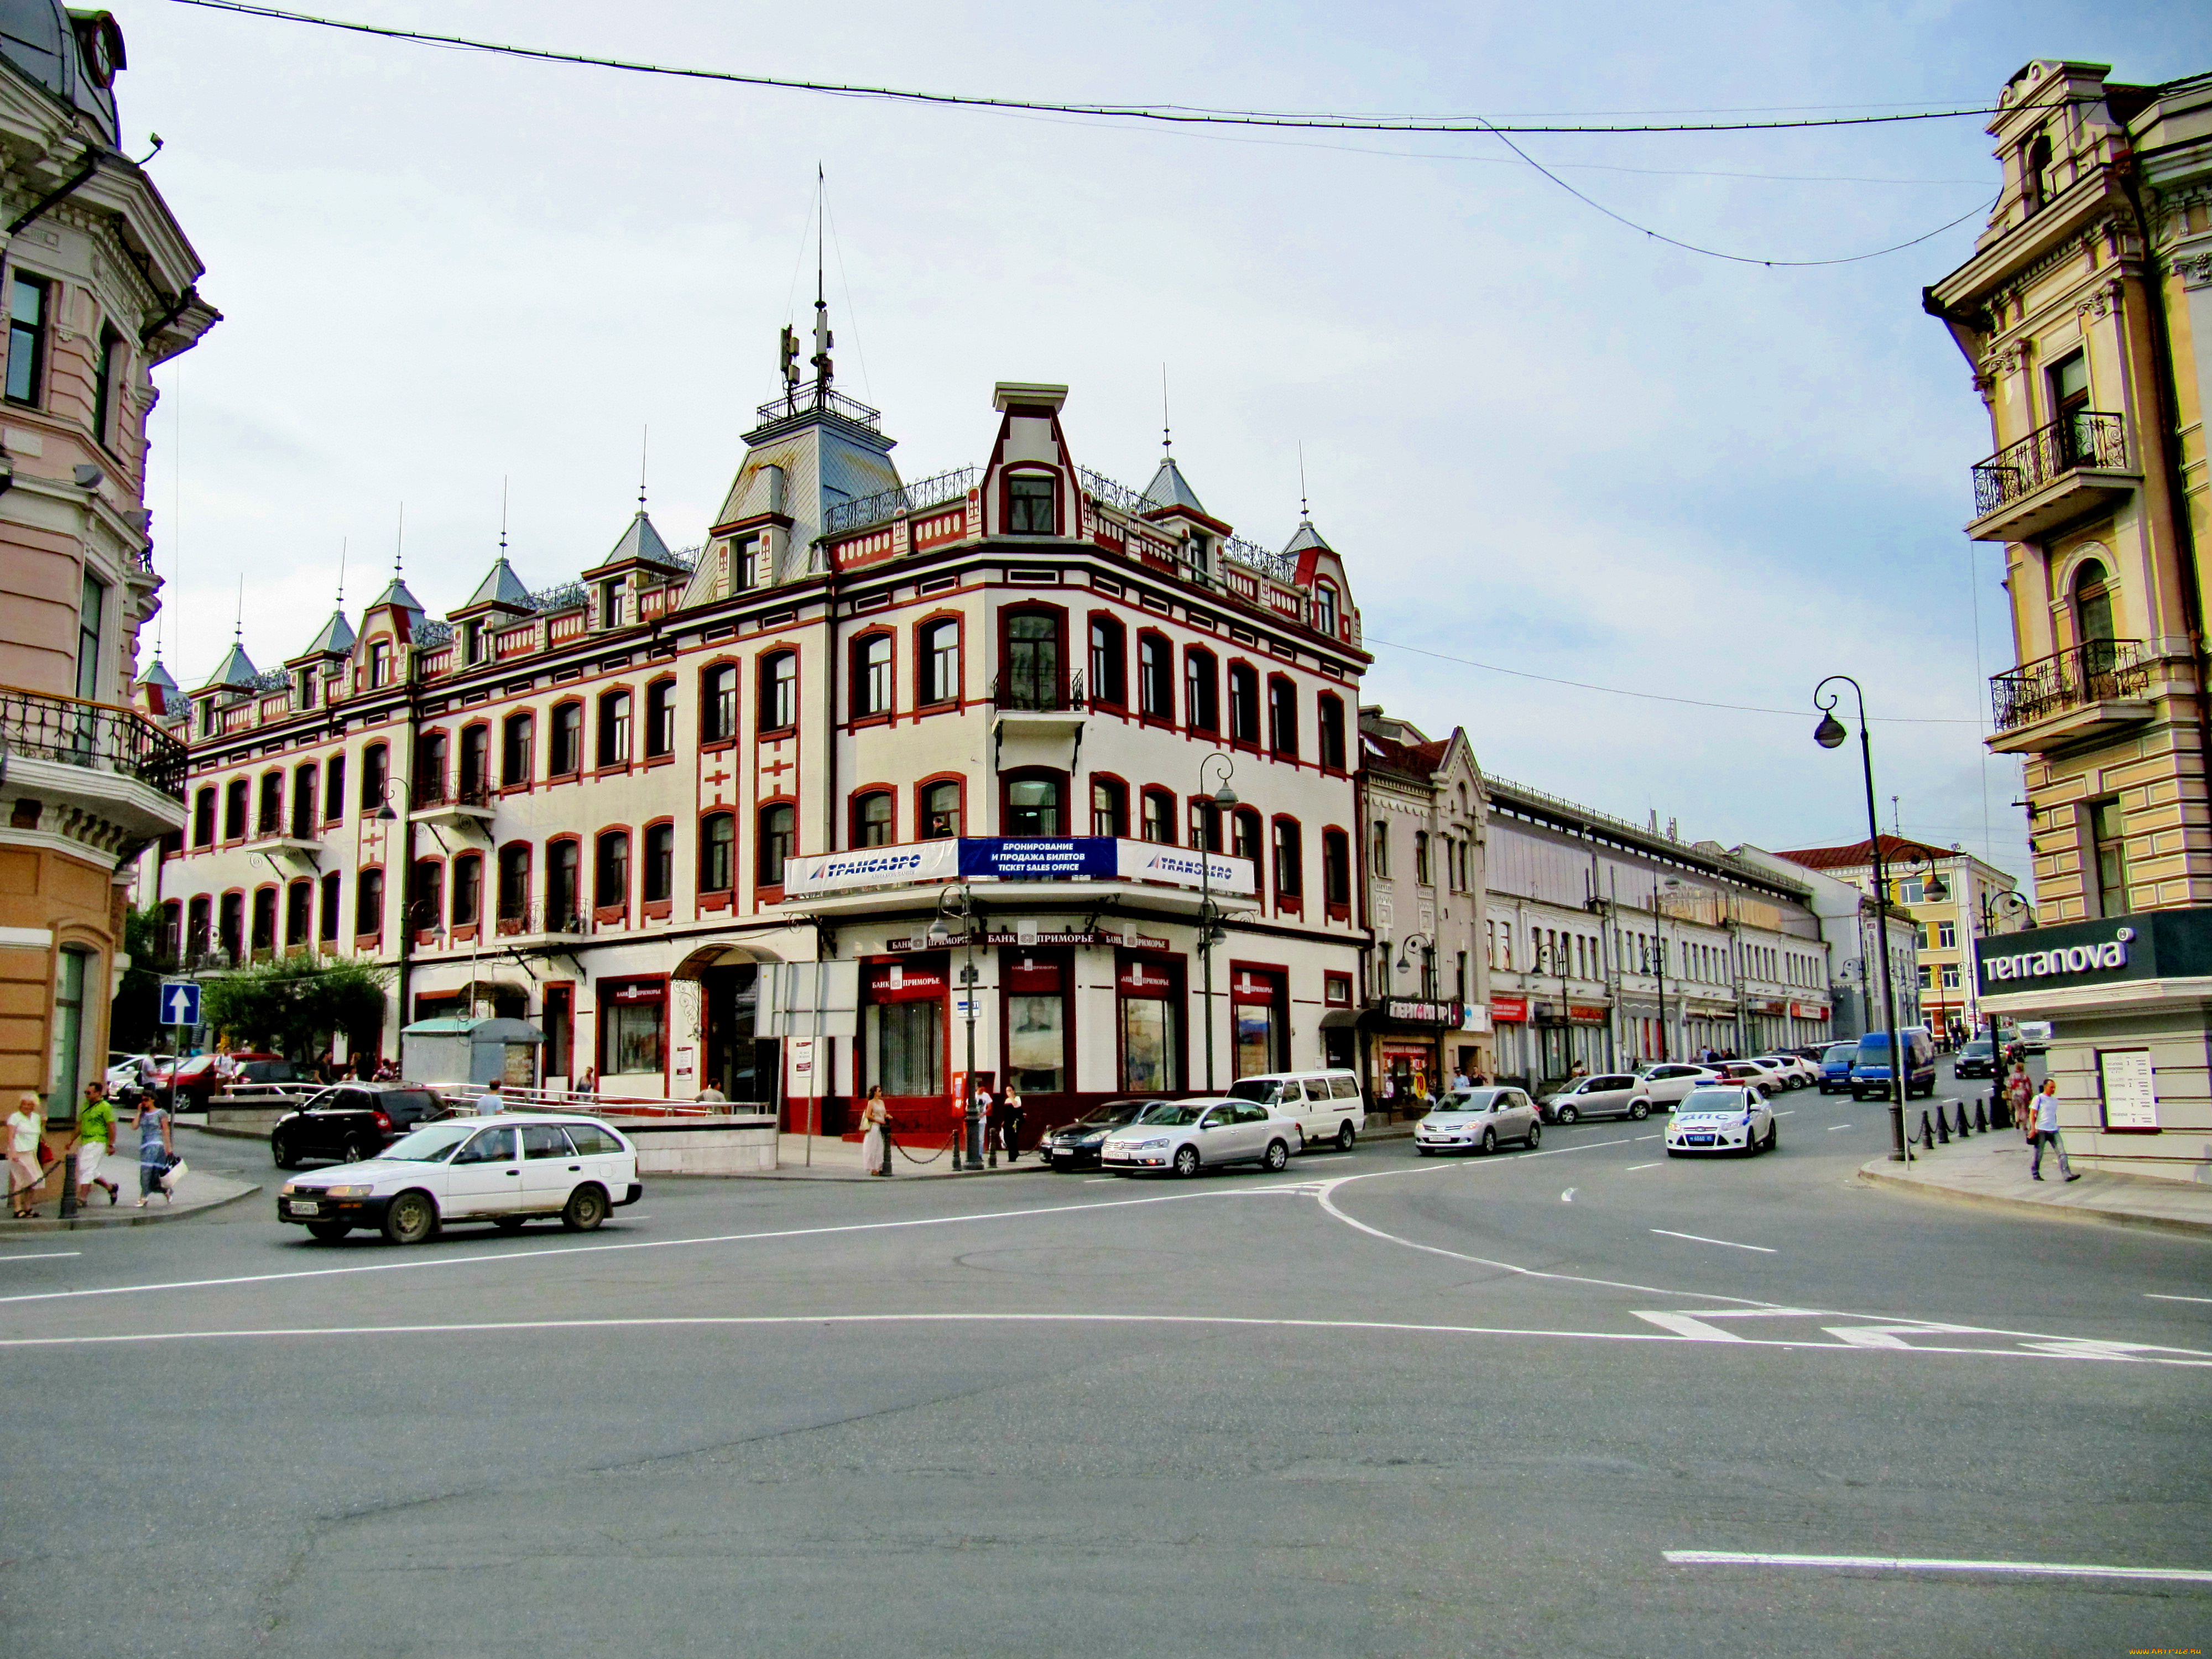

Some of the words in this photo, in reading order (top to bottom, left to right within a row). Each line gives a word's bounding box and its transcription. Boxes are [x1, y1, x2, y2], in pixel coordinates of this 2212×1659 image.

[828, 854, 921, 877] ТРАНСАЭРО
[988, 935, 1016, 943] БАНК
[1037, 935, 1094, 943] ПРИМОРЬЕ
[1106, 935, 1123, 945] БАНК
[903, 977, 940, 987] ПРИМОРЬЕ
[1680, 1113, 1729, 1121] ДПС
